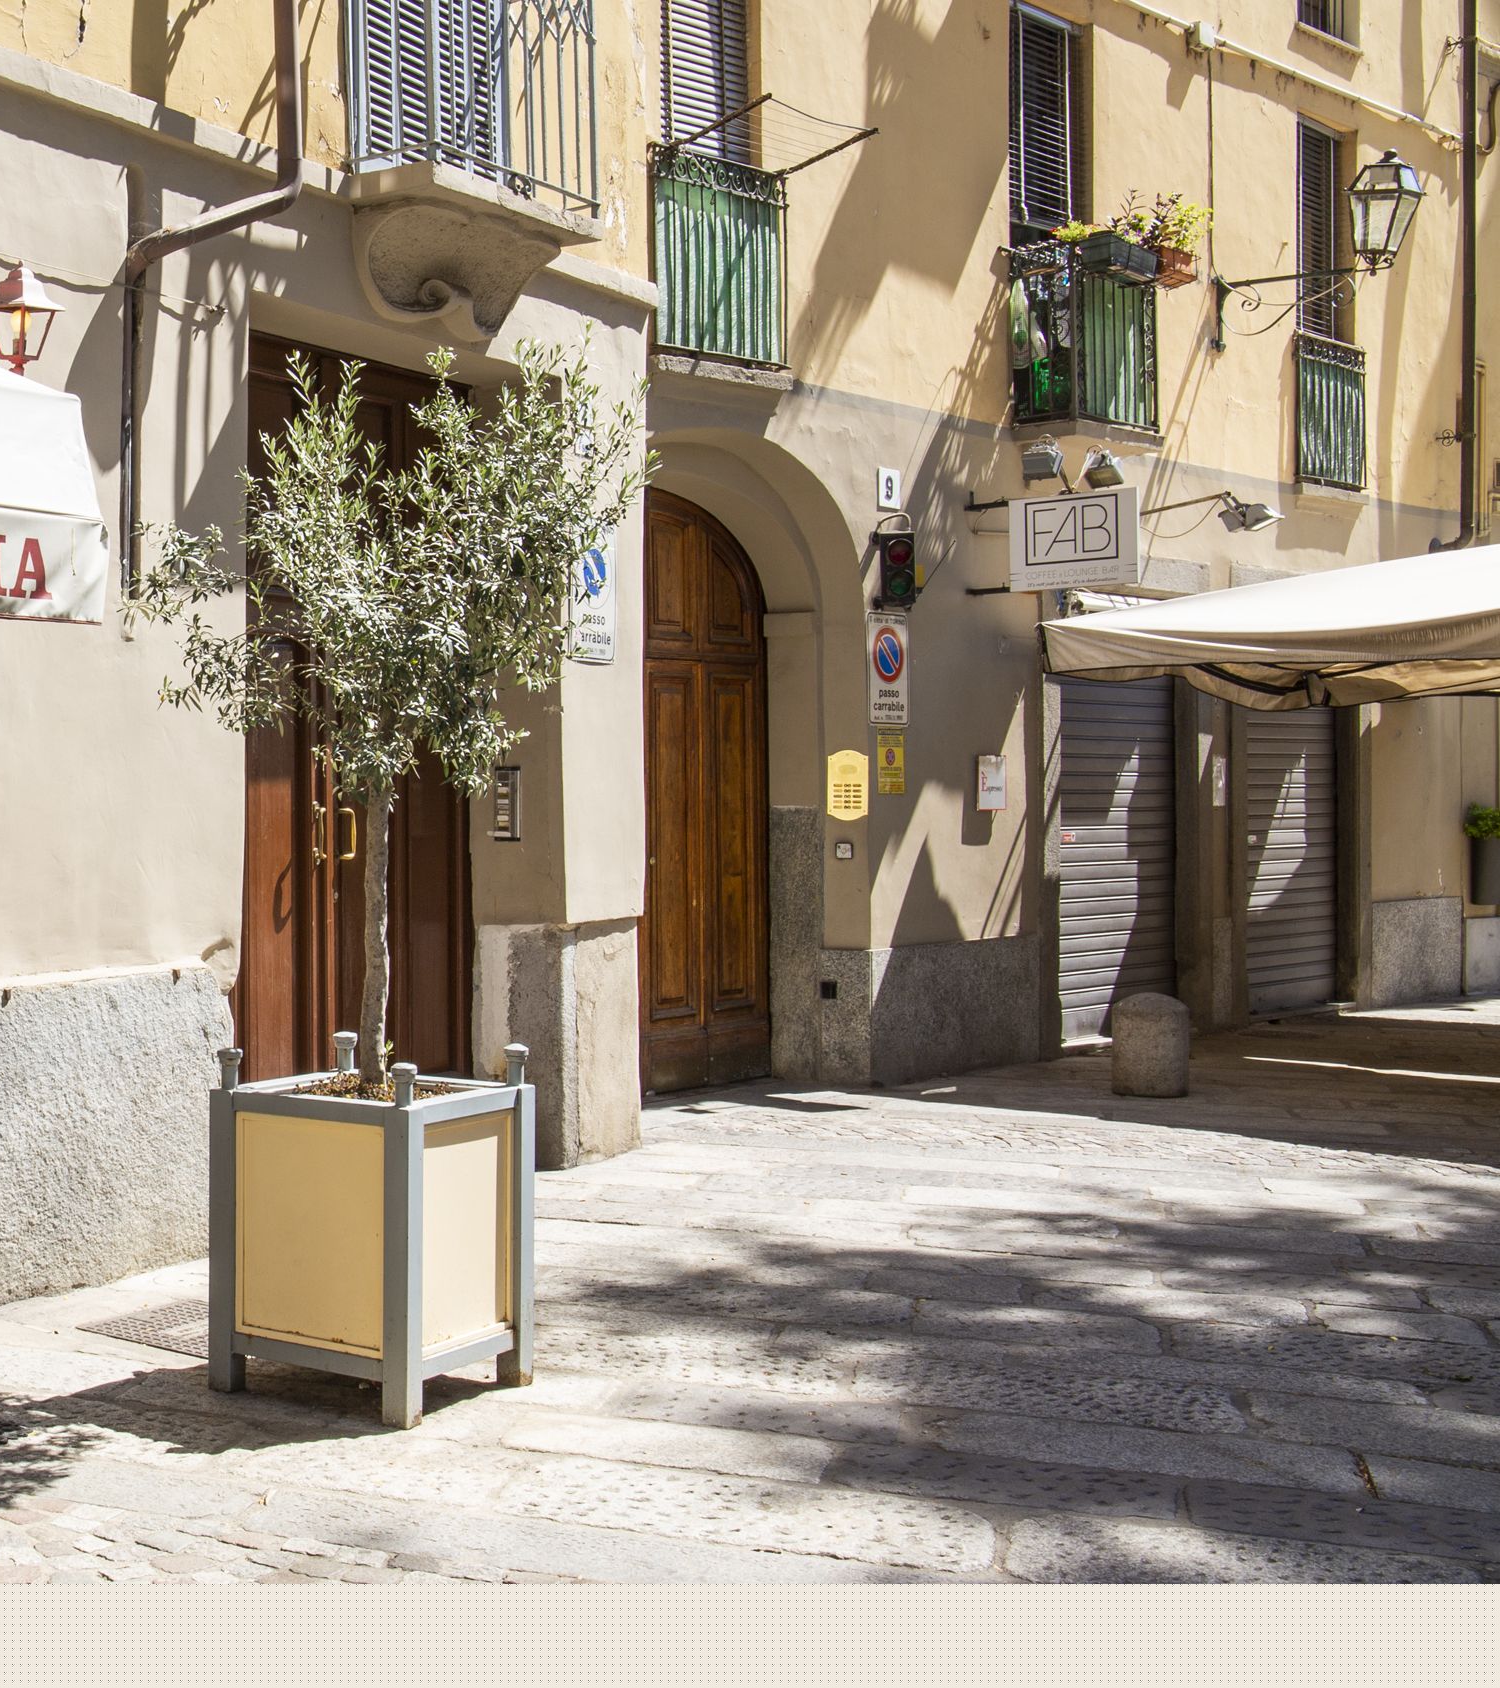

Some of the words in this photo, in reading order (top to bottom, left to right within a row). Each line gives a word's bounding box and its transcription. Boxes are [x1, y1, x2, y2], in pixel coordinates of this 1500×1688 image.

[884, 475, 893, 502] 9
[1033, 503, 1113, 558] FAB
[1025, 570, 1057, 581] COFFEE
[1064, 566, 1100, 578] LOUNGE
[1102, 565, 1120, 575] BAR
[580, 630, 611, 646] arrabile
[879, 689, 900, 699] passo
[873, 701, 905, 712] carrabile
